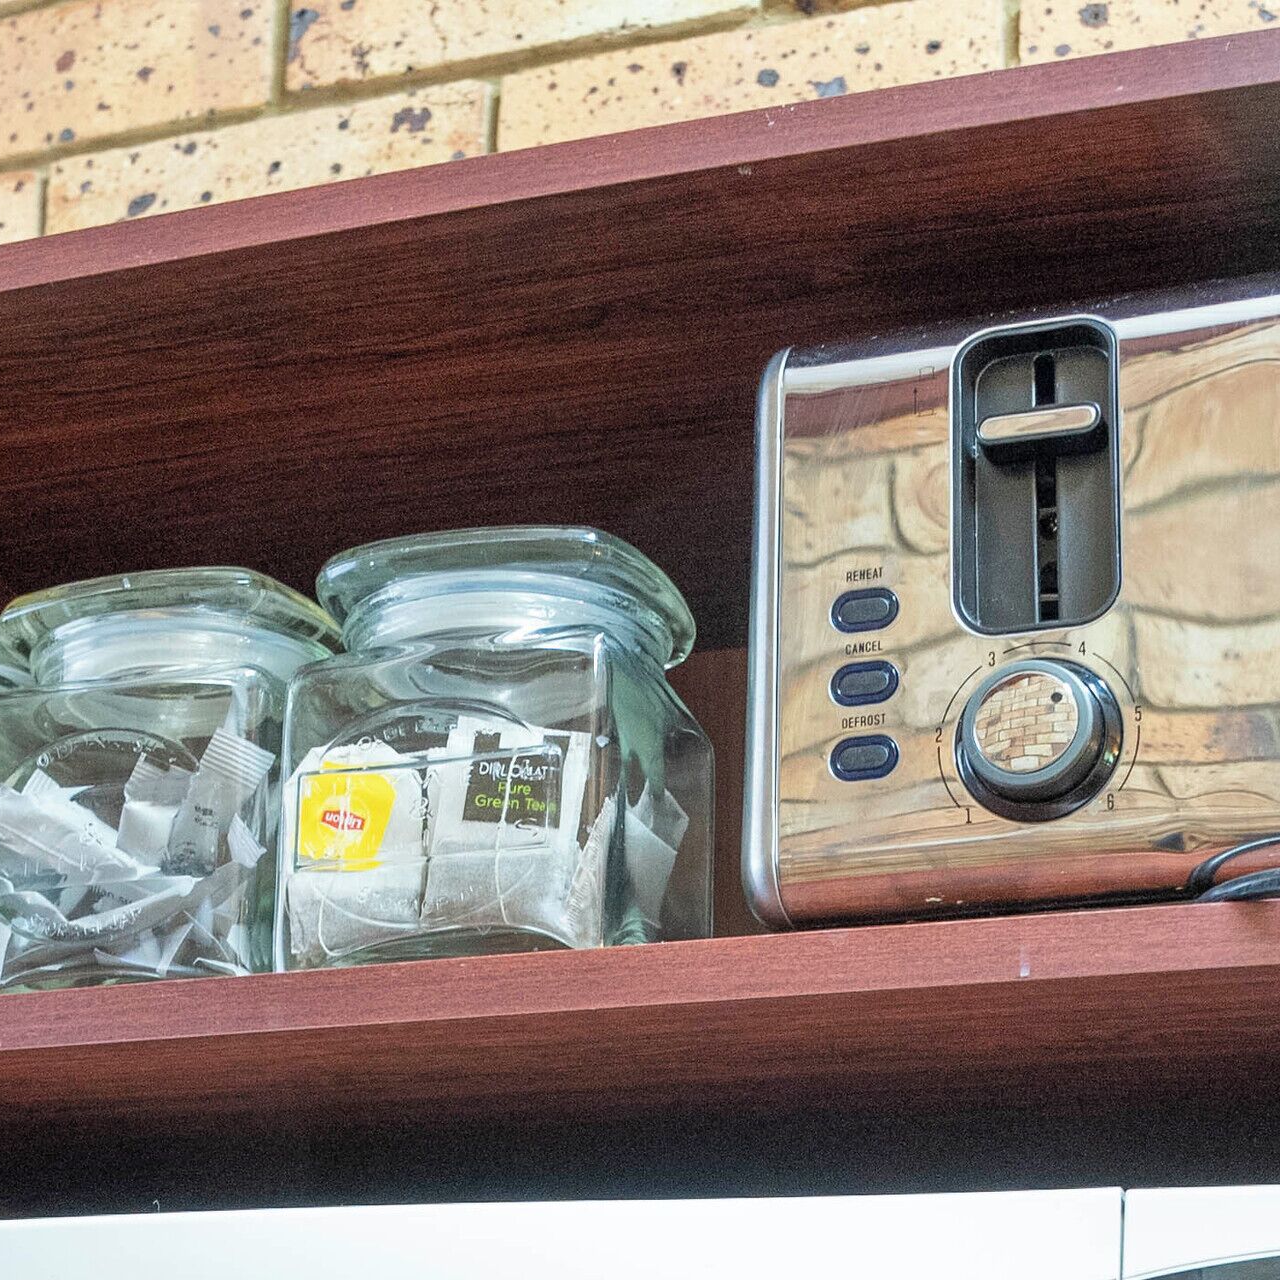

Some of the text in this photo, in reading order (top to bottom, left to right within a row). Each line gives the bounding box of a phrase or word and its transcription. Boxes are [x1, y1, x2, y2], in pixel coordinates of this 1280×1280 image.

[845, 566, 884, 583] REHEAT
[844, 640, 884, 656] CANCEL
[1078, 640, 1087, 656] 4
[988, 651, 997, 667] 3
[841, 712, 887, 730] DEFROST
[1134, 705, 1143, 722] 5
[935, 727, 943, 744] 2
[1106, 793, 1115, 811] 6
[965, 807, 973, 824] 1
